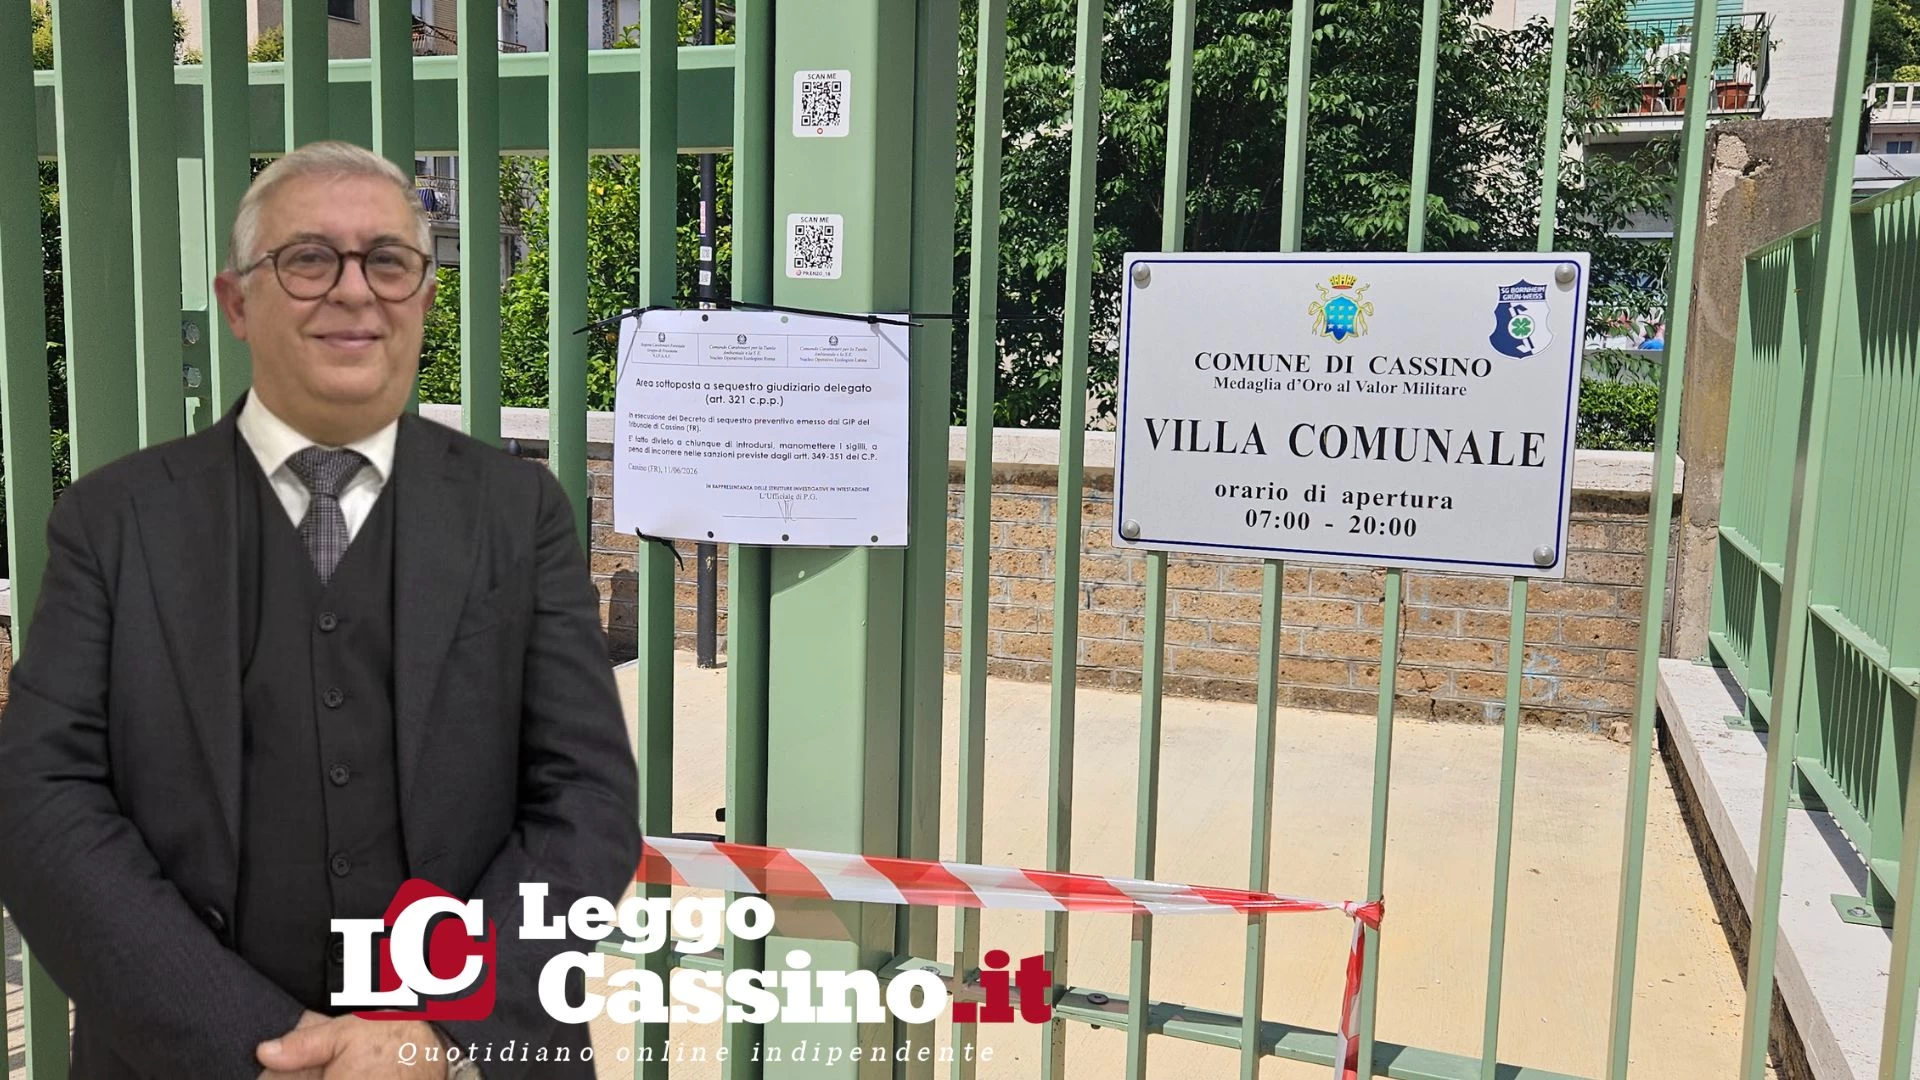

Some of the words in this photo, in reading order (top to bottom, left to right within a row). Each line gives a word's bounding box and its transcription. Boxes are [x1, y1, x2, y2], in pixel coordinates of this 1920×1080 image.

[1195, 352, 1310, 373] COMUNE
[1327, 355, 1353, 374] DI
[1369, 356, 1492, 378] CASSINO
[636, 378, 653, 387] Area
[656, 380, 700, 390] sottoposta
[704, 382, 710, 390] a
[714, 382, 763, 392] sequestro
[767, 382, 820, 394] giudiziario
[824, 383, 872, 394] delegato
[1213, 376, 1282, 394] Medaglia
[1337, 380, 1351, 393] al
[1356, 380, 1398, 395] Valor
[1403, 382, 1467, 396] Militare
[705, 394, 726, 405] (art.
[728, 395, 746, 404] 321
[749, 396, 784, 407] c.p.p.)
[628, 420, 653, 429] Tribunale
[680, 415, 706, 423] Decreto
[708, 415, 715, 423] di
[717, 417, 752, 425] sequestro
[754, 418, 794, 426] preventivo
[651, 437, 674, 445] divieto
[685, 440, 721, 448] chiunque
[736, 441, 776, 450] introdursi,
[779, 442, 836, 450] manomettere
[845, 443, 868, 452] sigilli,
[1144, 417, 1267, 455] VILLA
[1289, 422, 1546, 468] COMUNALE
[628, 446, 643, 454] pena
[645, 446, 651, 454] di
[651, 447, 682, 456] incorrere
[683, 449, 702, 457] nelle
[703, 450, 735, 459] sanzioni
[736, 451, 769, 460] previste
[770, 452, 792, 461] dagli
[628, 462, 647, 472] Cassino
[647, 464, 663, 474] (FR),
[664, 465, 699, 475] 11/06/2026
[1215, 482, 1288, 501] orario
[1305, 484, 1326, 502] di
[1342, 489, 1453, 511] apertura
[1245, 508, 1311, 531] 07:00
[1349, 514, 1417, 538] 20:00
